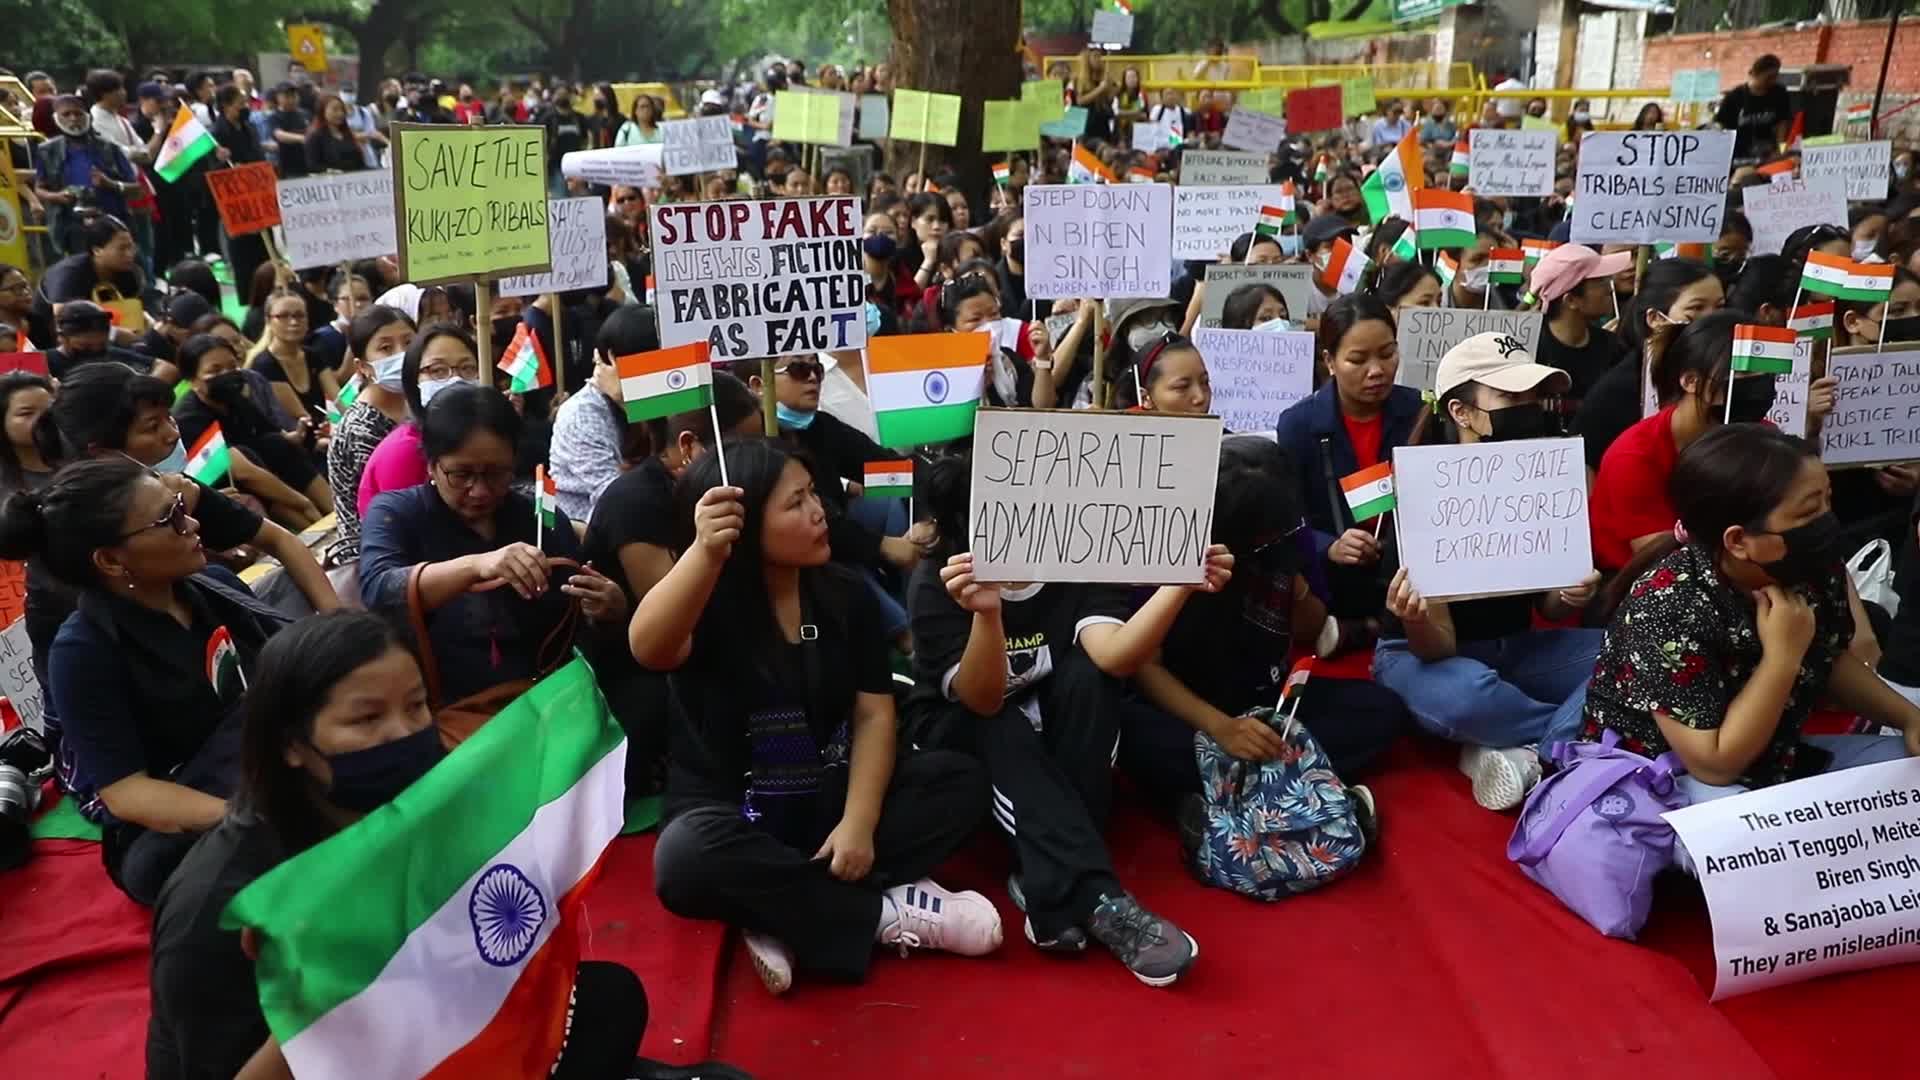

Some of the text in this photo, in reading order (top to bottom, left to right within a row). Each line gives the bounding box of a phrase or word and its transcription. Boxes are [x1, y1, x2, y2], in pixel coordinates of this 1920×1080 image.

[408, 137, 488, 191] SAVE
[493, 136, 540, 179] THE
[1616, 133, 1700, 167] STOP
[1177, 191, 1193, 203] NO
[1195, 190, 1219, 201] MORE
[1582, 173, 1728, 196] TRIBALS ETHNIC
[1029, 189, 1151, 213] STEP DOWN
[1176, 208, 1191, 217] NO
[1195, 208, 1220, 217] MORE
[407, 199, 545, 244] KUKI-ZO TRIBALS
[657, 199, 855, 245] STOP FAKE
[1034, 221, 1146, 249] N BIREN
[1591, 203, 1718, 235] CLEANSING
[664, 237, 864, 281] NEWS, FICTION
[1054, 254, 1140, 281] SINGH
[671, 273, 864, 324] FABRICATED
[1053, 280, 1088, 295] BIREN
[708, 312, 857, 357] AS FACT
[1200, 333, 1265, 357] ARAMBAI
[1408, 312, 1532, 346] STOP KILLING
[1214, 356, 1296, 375] RESPONSIBLE
[1831, 362, 1884, 383] STAND
[1234, 377, 1258, 387] FOR
[1831, 385, 1882, 402] SPEAK
[1825, 407, 1897, 429] JUSTICE
[1825, 432, 1876, 451] KUKI
[985, 429, 1176, 490] SEPARATE
[1434, 447, 1576, 489] STOP STATE
[1431, 486, 1584, 528] SPONSORED
[972, 501, 1212, 568] ADMINISTRATION
[1434, 527, 1552, 564] EXTREMISM
[1740, 812, 1782, 832] The
[1783, 801, 1824, 825] real
[1825, 788, 1908, 818] terrorists
[1704, 841, 1787, 875] Arambai
[1788, 828, 1869, 858] Tenggol,
[1815, 864, 1865, 891] Biren
[1763, 916, 1781, 937] &
[1784, 898, 1887, 933] Sanajaoba
[1729, 954, 1780, 978] They
[1784, 948, 1817, 968] are
